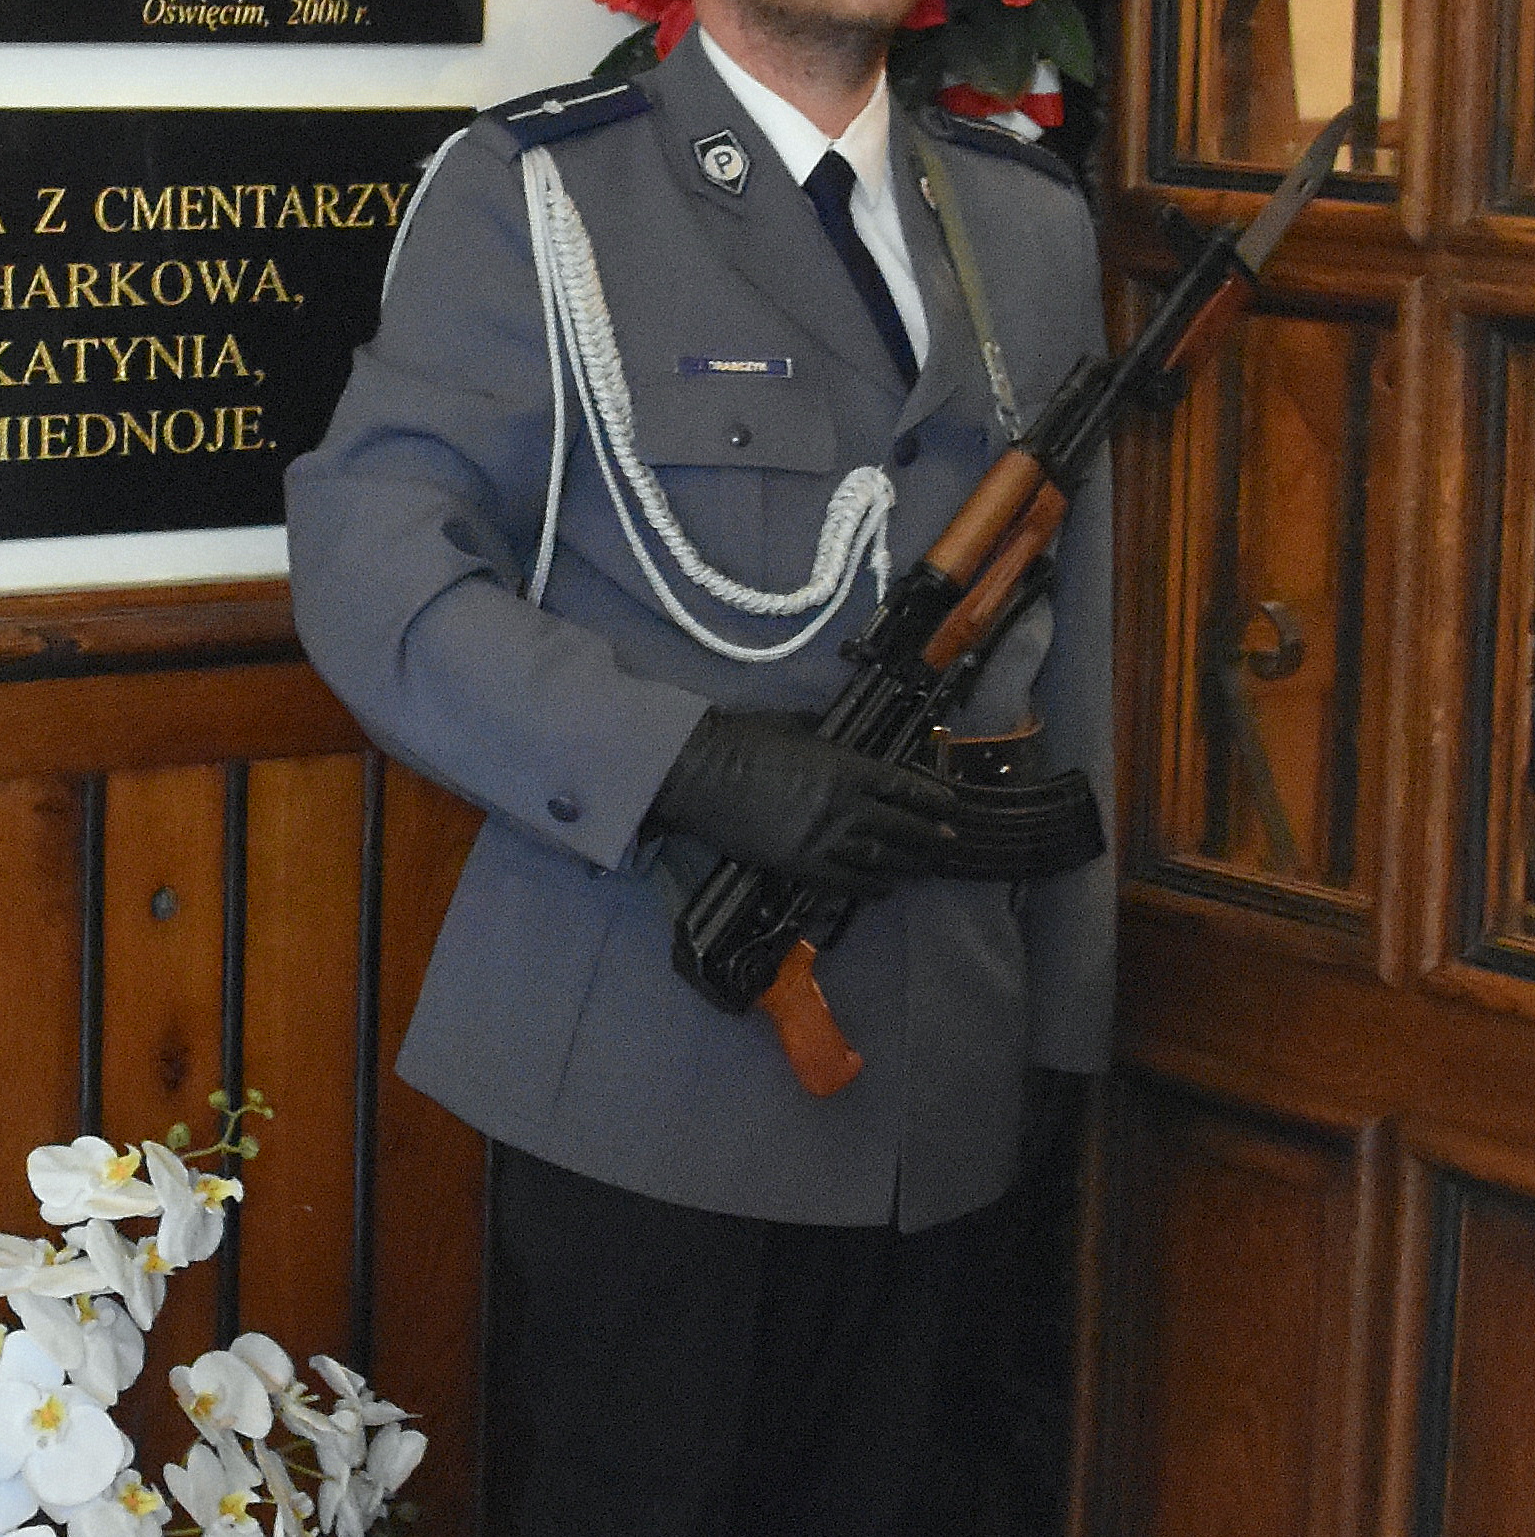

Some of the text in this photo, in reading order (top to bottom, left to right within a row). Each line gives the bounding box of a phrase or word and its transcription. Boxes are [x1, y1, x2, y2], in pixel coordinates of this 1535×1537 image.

[354, 6, 371, 25] r.
[36, 187, 67, 234] Z
[93, 182, 410, 234] CMENTARZY
